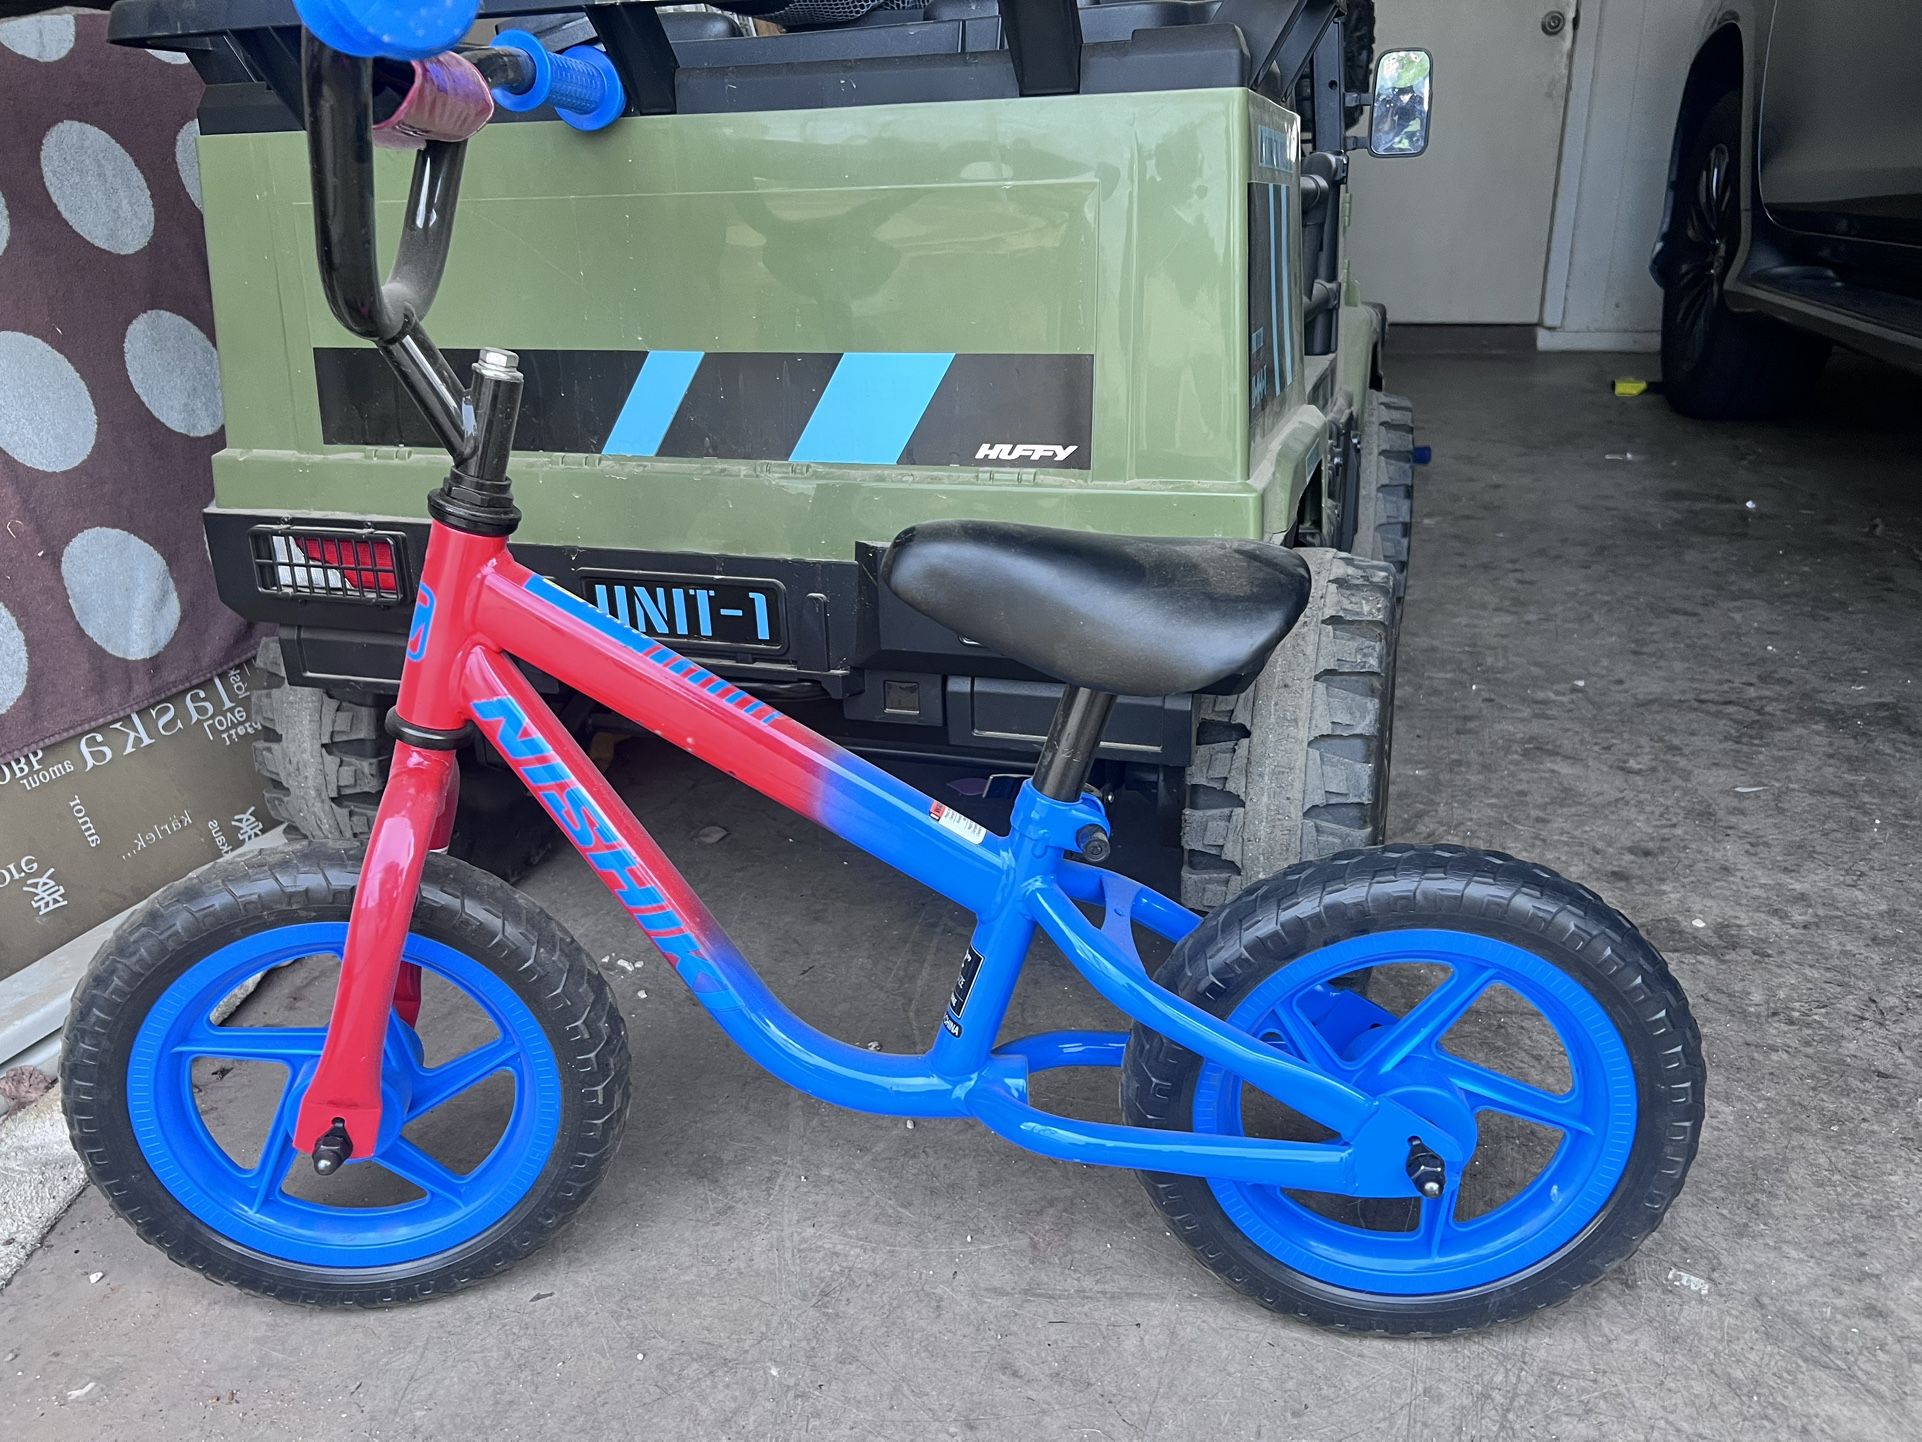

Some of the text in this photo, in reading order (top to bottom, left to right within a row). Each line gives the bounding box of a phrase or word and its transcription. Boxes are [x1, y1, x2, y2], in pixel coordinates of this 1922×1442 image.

[975, 443, 1078, 461] HUFFY
[595, 584, 770, 640] UNIT-1
[470, 694, 746, 1010] NISHIKI
